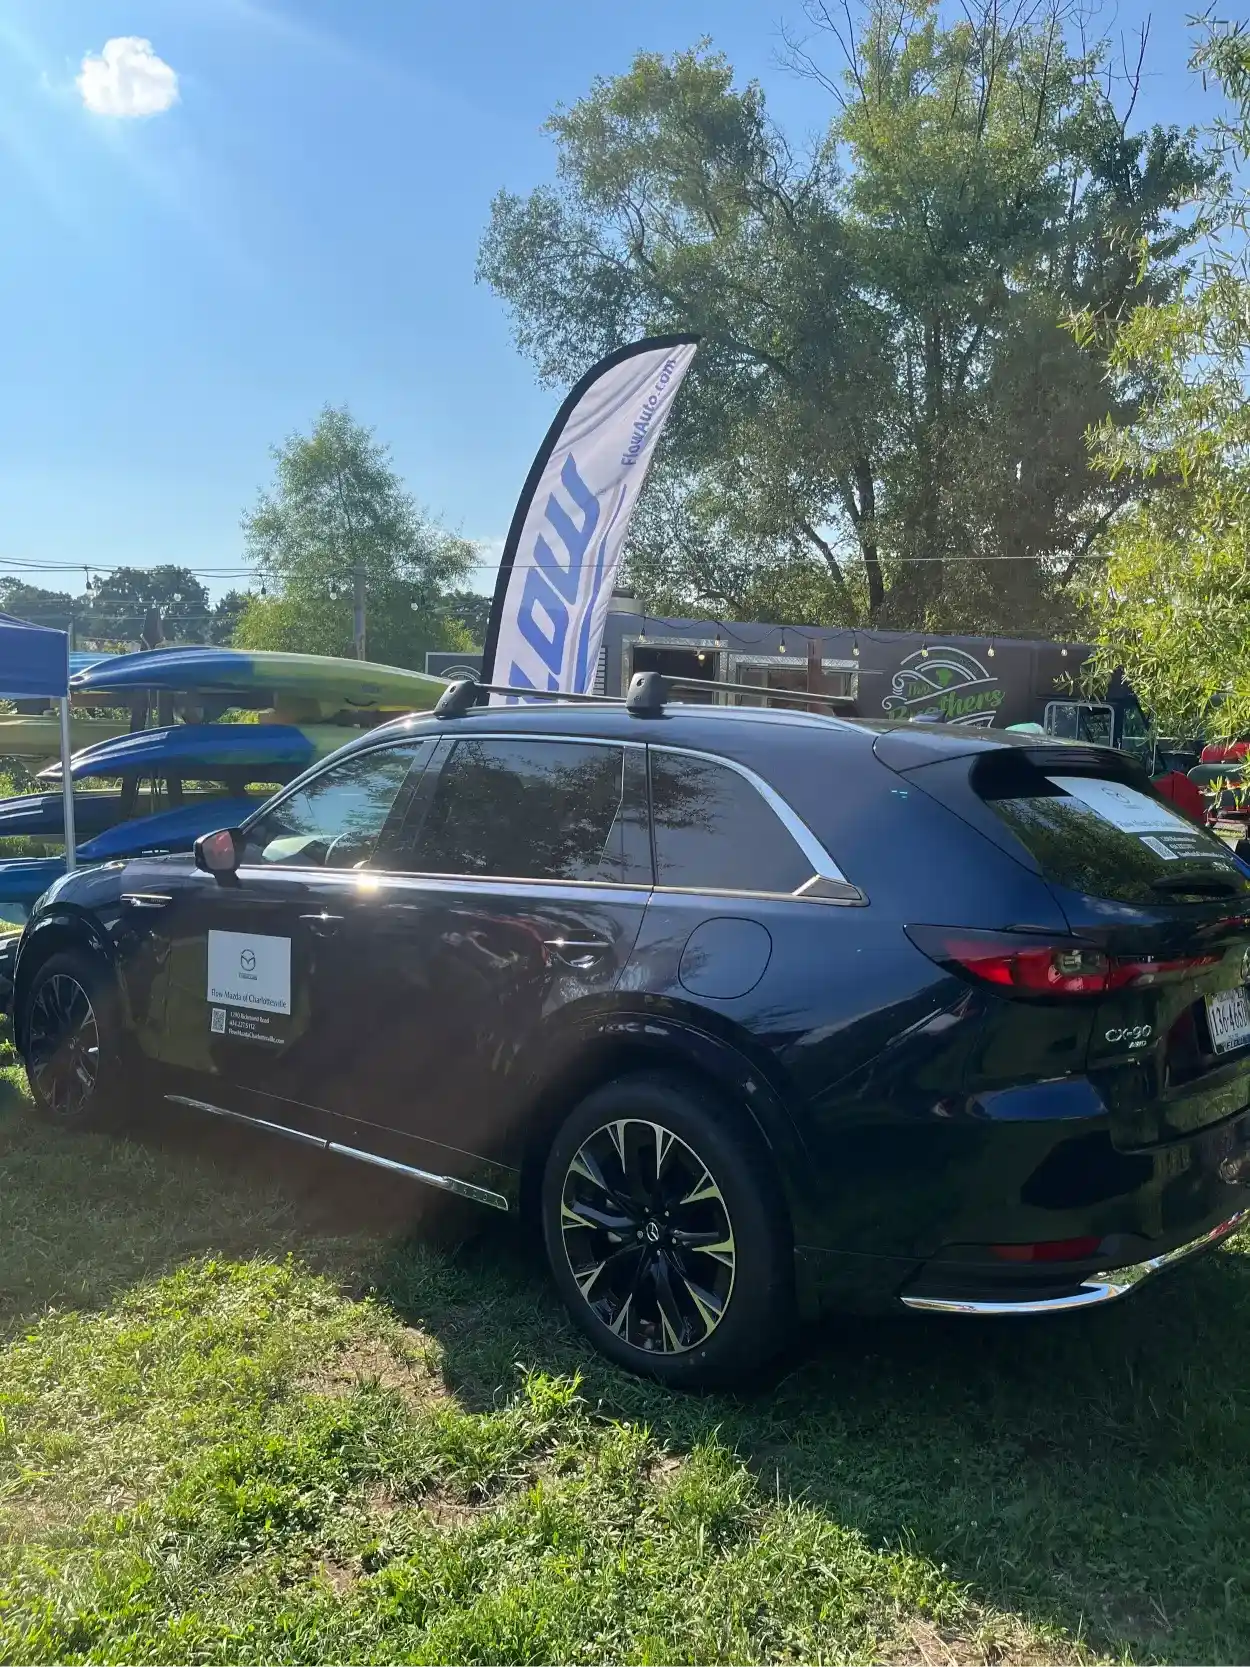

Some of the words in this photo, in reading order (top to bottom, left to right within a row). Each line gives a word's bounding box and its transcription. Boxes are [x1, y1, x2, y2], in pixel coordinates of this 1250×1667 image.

[621, 359, 676, 466] FlowAuto.com
[505, 451, 601, 705] LOW
[212, 988, 223, 998] Flow
[224, 991, 241, 1001] Mazda
[1105, 1024, 1152, 1042] CX-90
